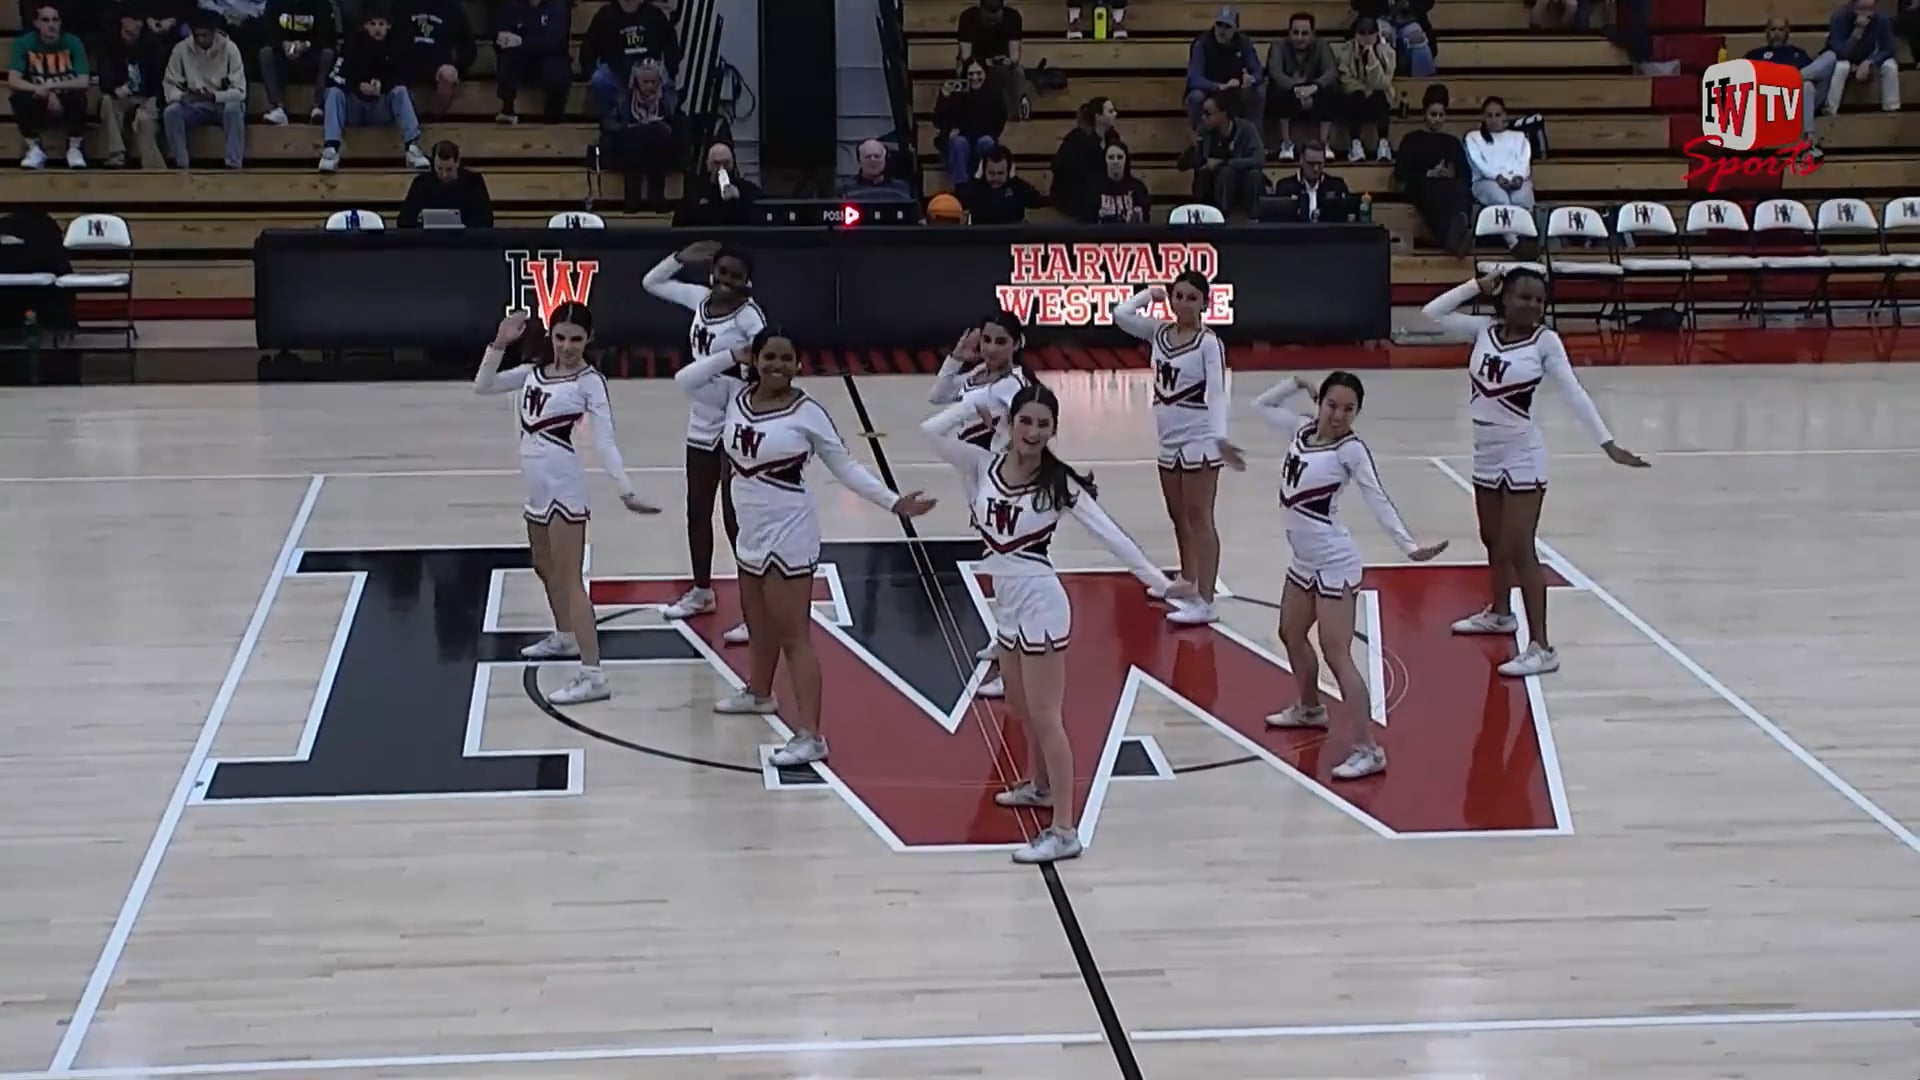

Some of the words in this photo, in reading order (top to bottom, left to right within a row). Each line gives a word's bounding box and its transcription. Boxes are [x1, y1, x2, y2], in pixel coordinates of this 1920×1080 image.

[1010, 243, 1218, 284] HARVARD
[505, 249, 599, 331] HW
[1479, 353, 1512, 383] HW
[524, 385, 552, 417] HW
[734, 423, 766, 459] HW
[986, 497, 1023, 536] HW
